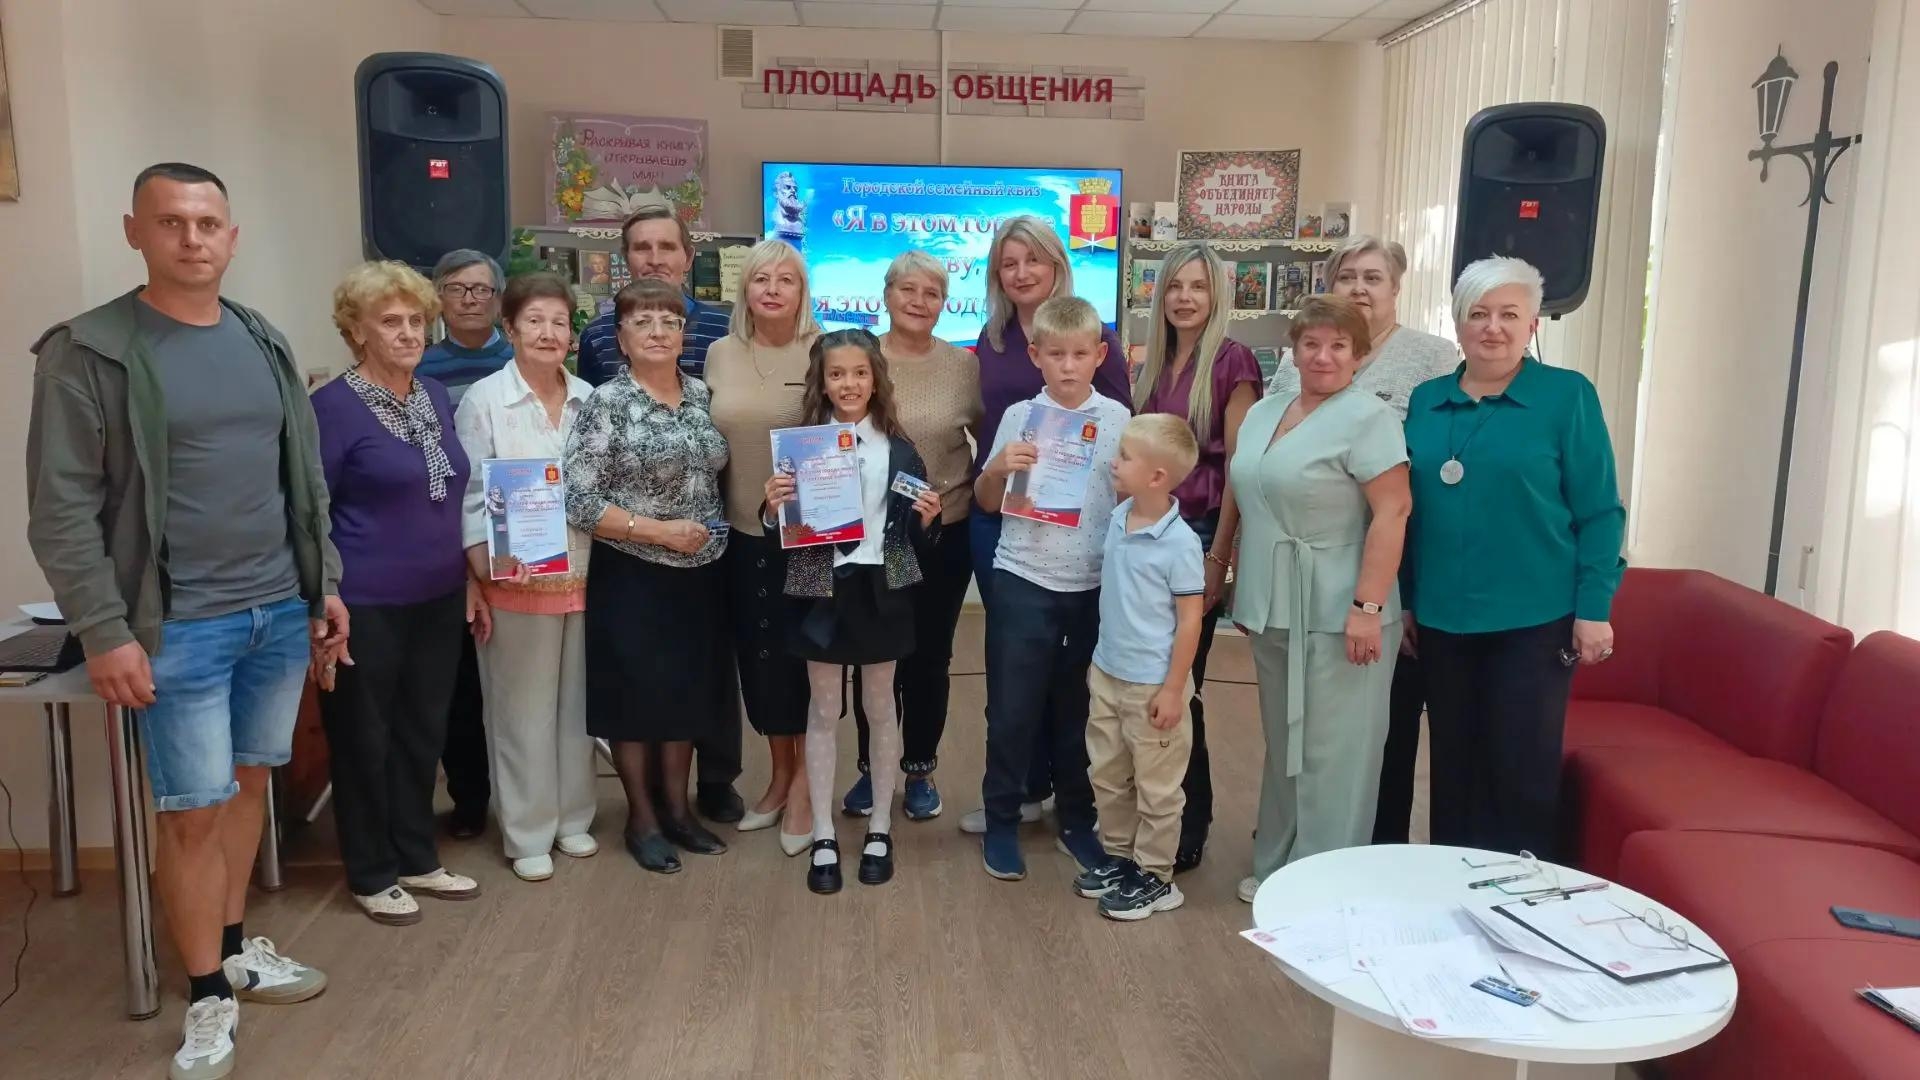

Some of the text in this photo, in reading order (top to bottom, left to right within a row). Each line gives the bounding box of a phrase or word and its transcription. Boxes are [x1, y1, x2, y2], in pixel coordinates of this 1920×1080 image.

[763, 69, 1113, 105] ПЛОЩАДЬ ОБЩЕНИЯ
[842, 177, 1041, 198] Городской семейный квиз
[1219, 173, 1259, 187] КНИГА
[1200, 187, 1277, 202] ОБЪЕДИНЯЕТ
[1215, 202, 1262, 216] НАРОДЫ
[832, 205, 867, 232] «Я
[891, 213, 957, 233] этом
